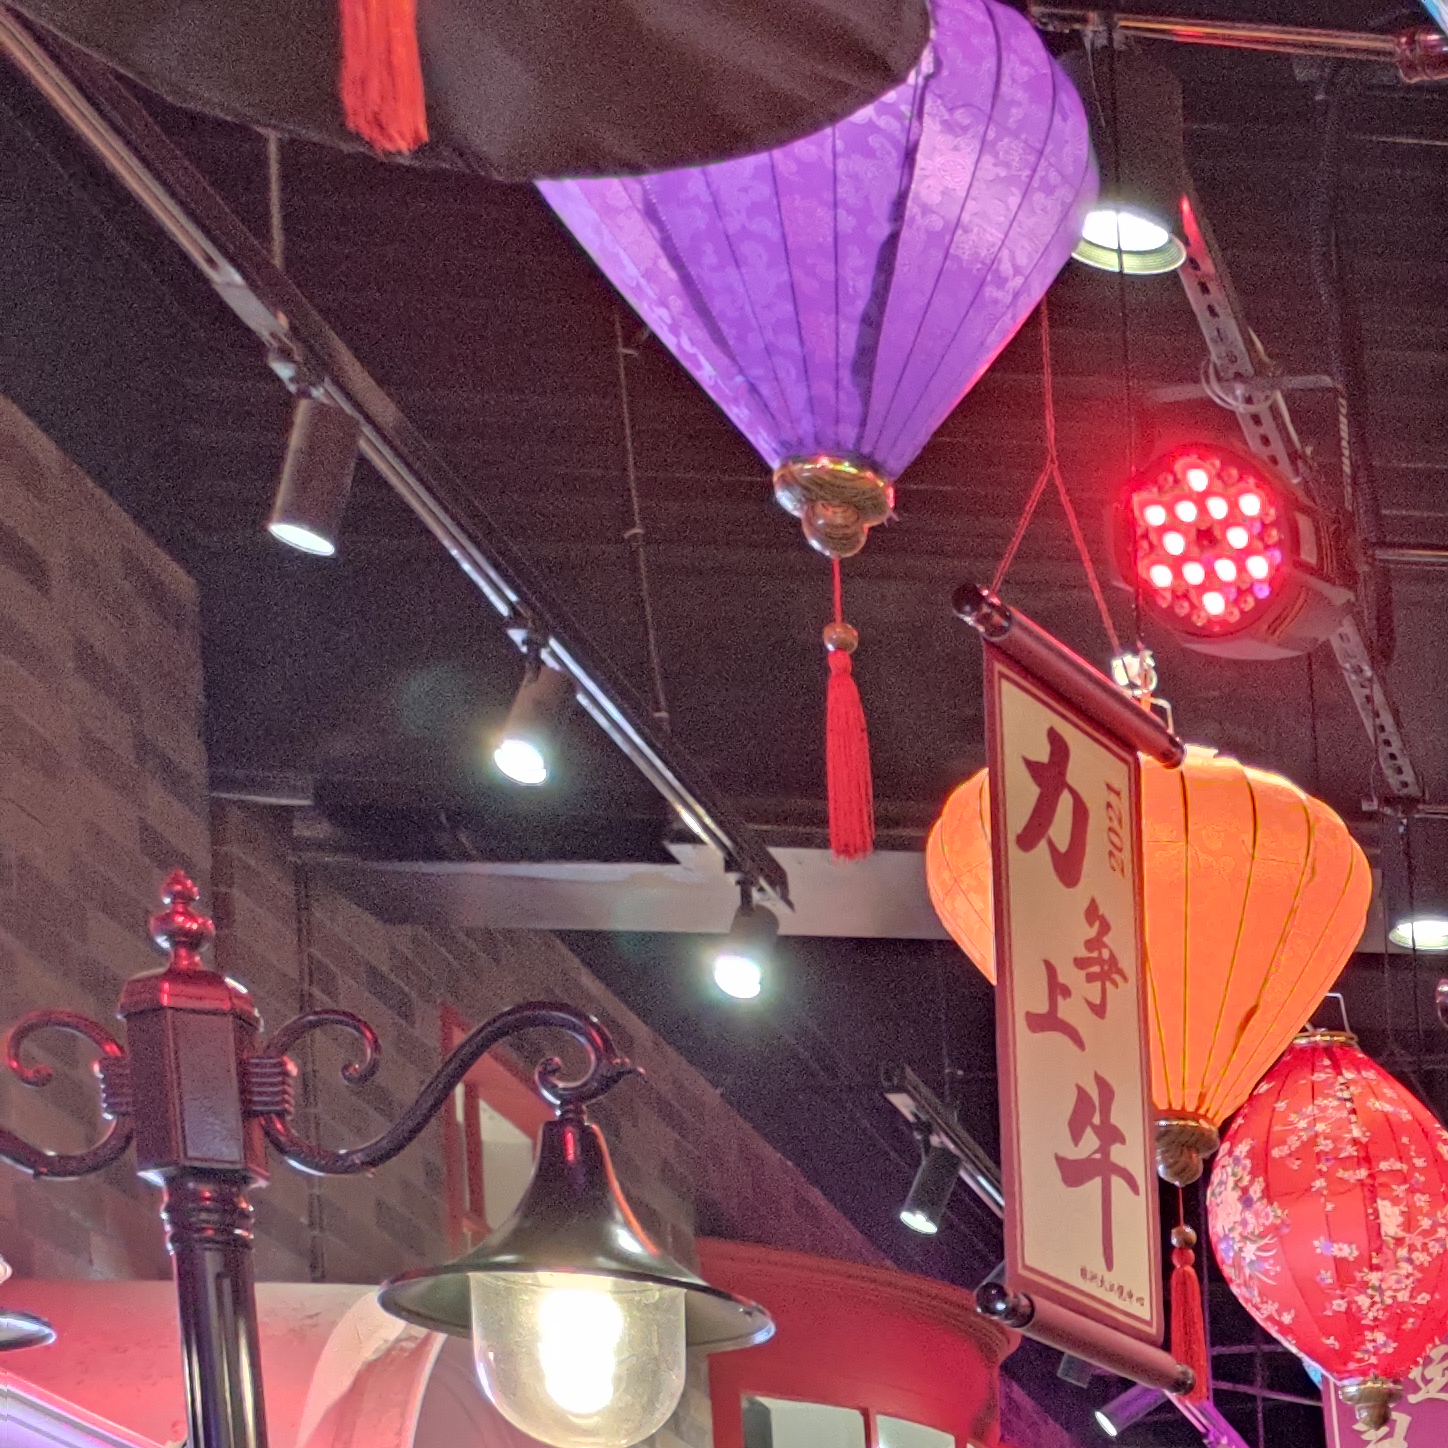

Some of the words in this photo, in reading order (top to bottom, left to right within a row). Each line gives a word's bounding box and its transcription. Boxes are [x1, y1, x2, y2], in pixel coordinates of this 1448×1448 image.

[1104, 780, 1128, 876] 2021
[1014, 724, 1142, 1274] 力争上牛
